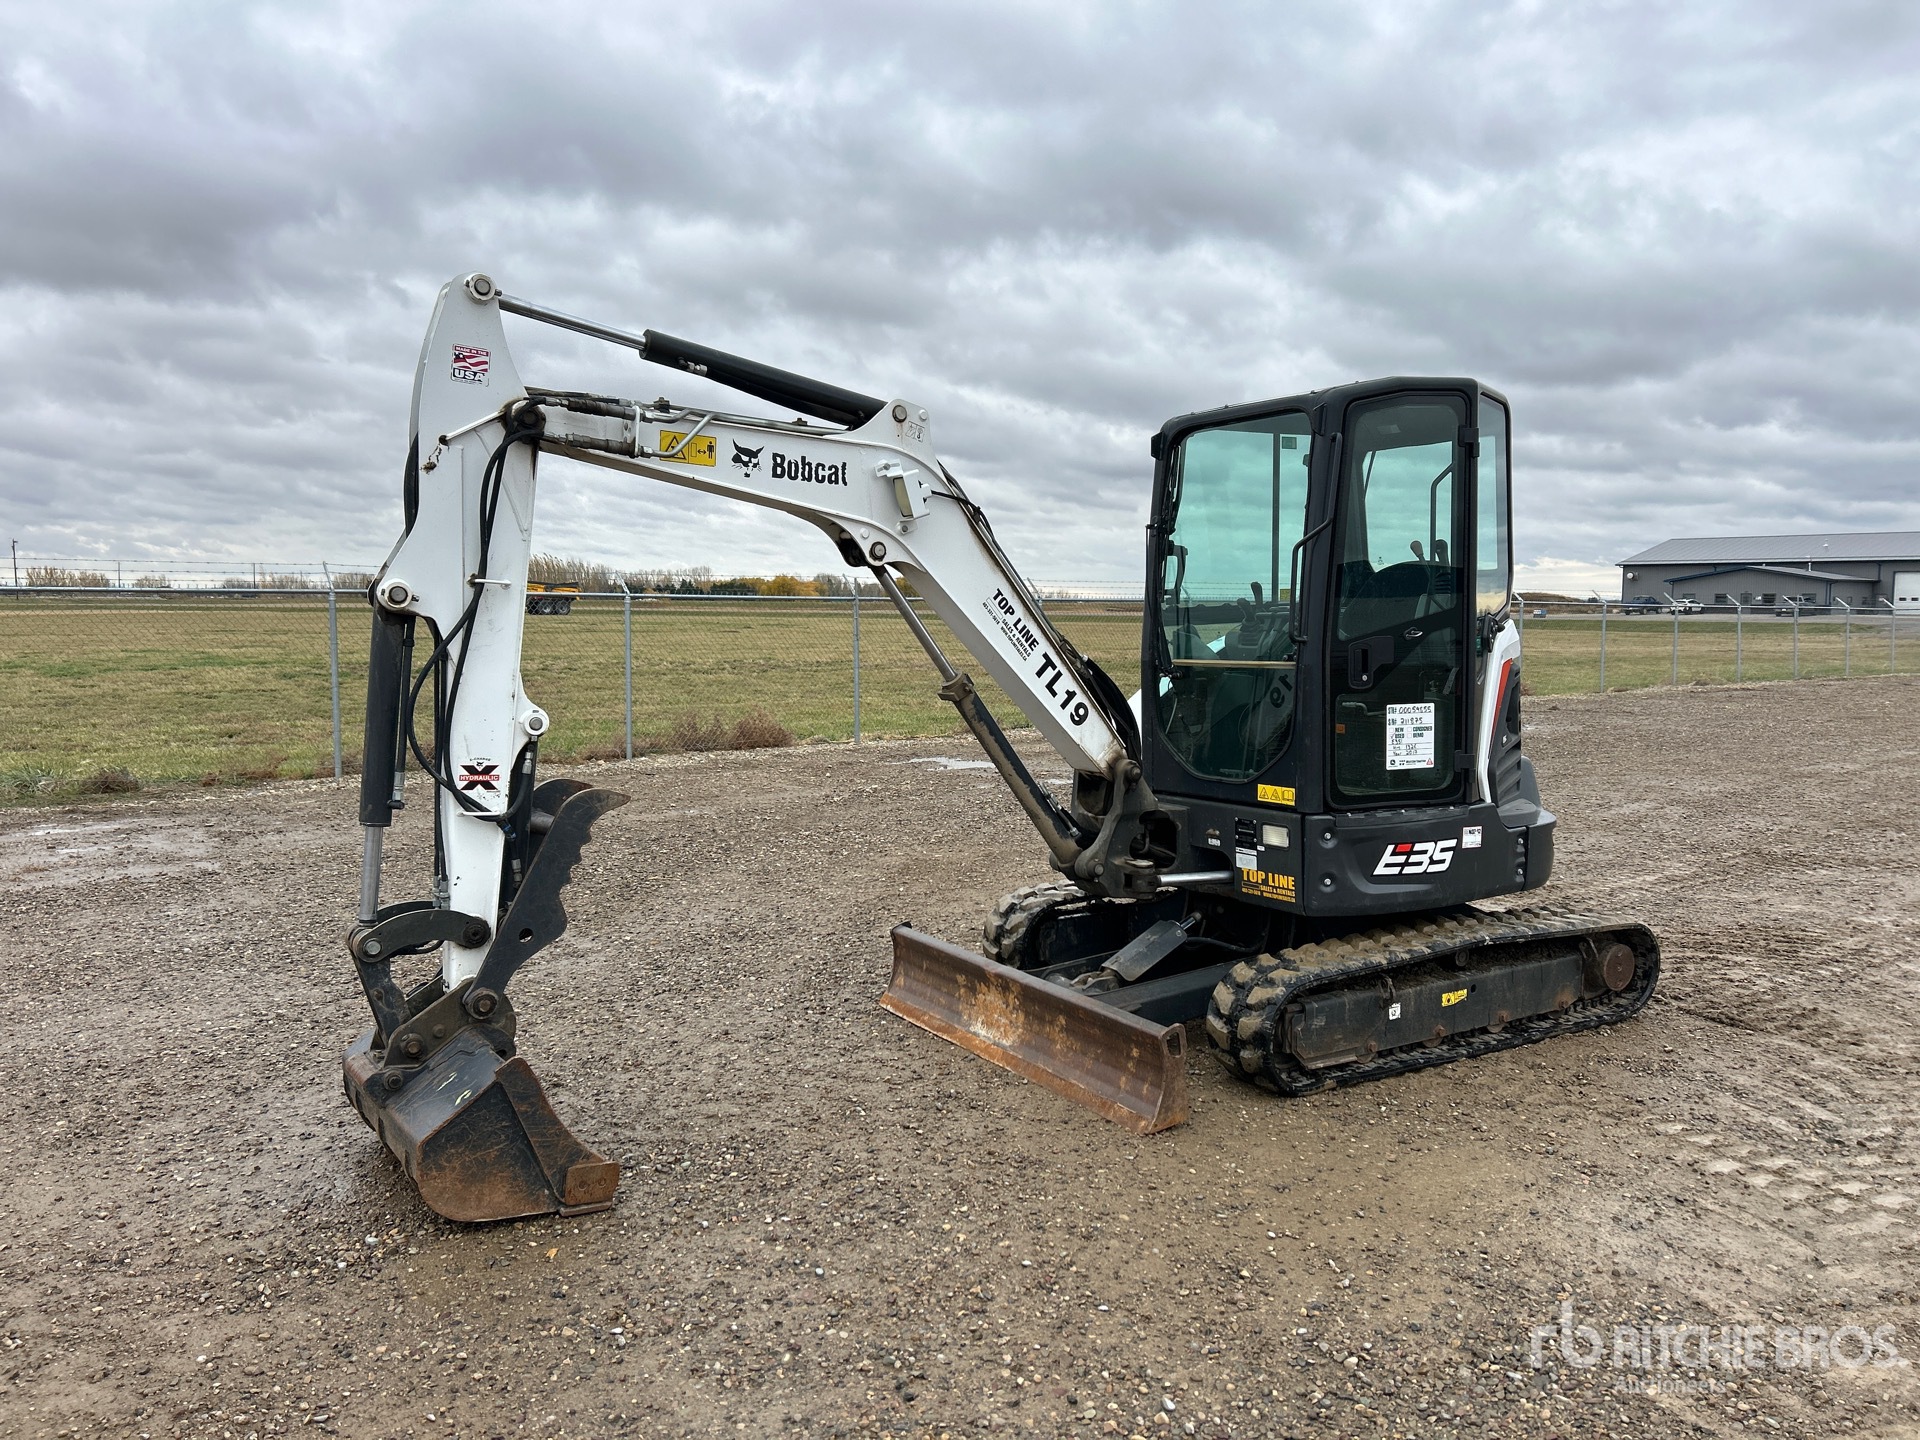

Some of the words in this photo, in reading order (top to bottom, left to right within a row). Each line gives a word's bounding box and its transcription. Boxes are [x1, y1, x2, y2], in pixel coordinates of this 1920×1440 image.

[454, 368, 484, 381] USA
[771, 452, 848, 487] Bobcat
[992, 588, 1015, 616] TOP
[1012, 617, 1040, 652] LINE
[1001, 618, 1015, 635] SALES
[1015, 636, 1032, 658] RENTALS
[1035, 651, 1089, 727] TL19
[1372, 838, 1458, 876] E35
[1242, 868, 1265, 883] TOP
[1268, 873, 1295, 889] LINE
[1277, 888, 1295, 897] RENTALS
